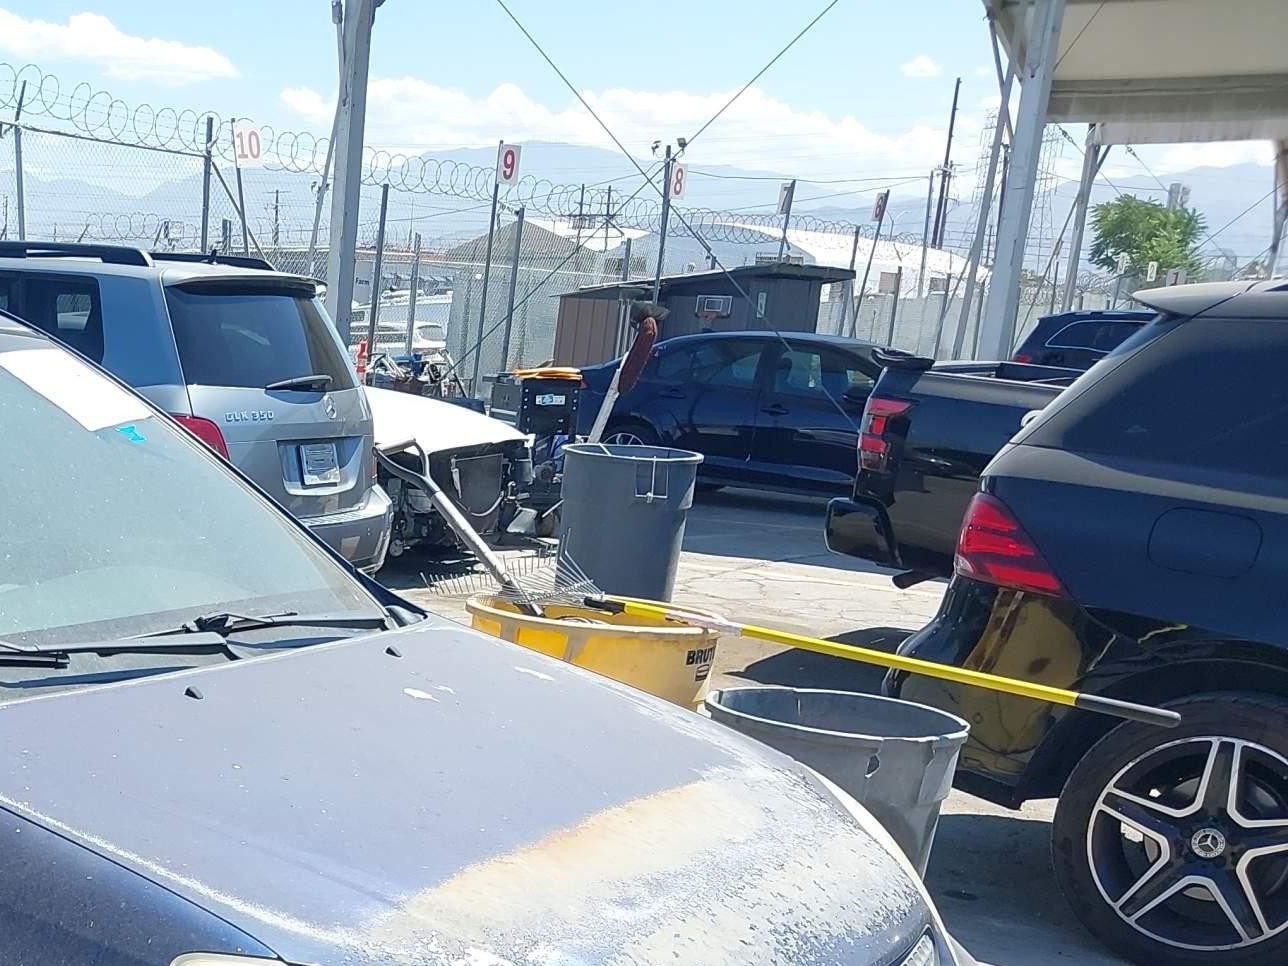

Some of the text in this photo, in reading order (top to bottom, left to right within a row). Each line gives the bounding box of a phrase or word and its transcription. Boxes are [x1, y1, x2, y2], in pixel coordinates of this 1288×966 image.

[236, 130, 261, 159] 10
[503, 149, 515, 180] 9
[674, 167, 683, 196] 8
[781, 186, 793, 211] 7
[252, 409, 274, 421] 350
